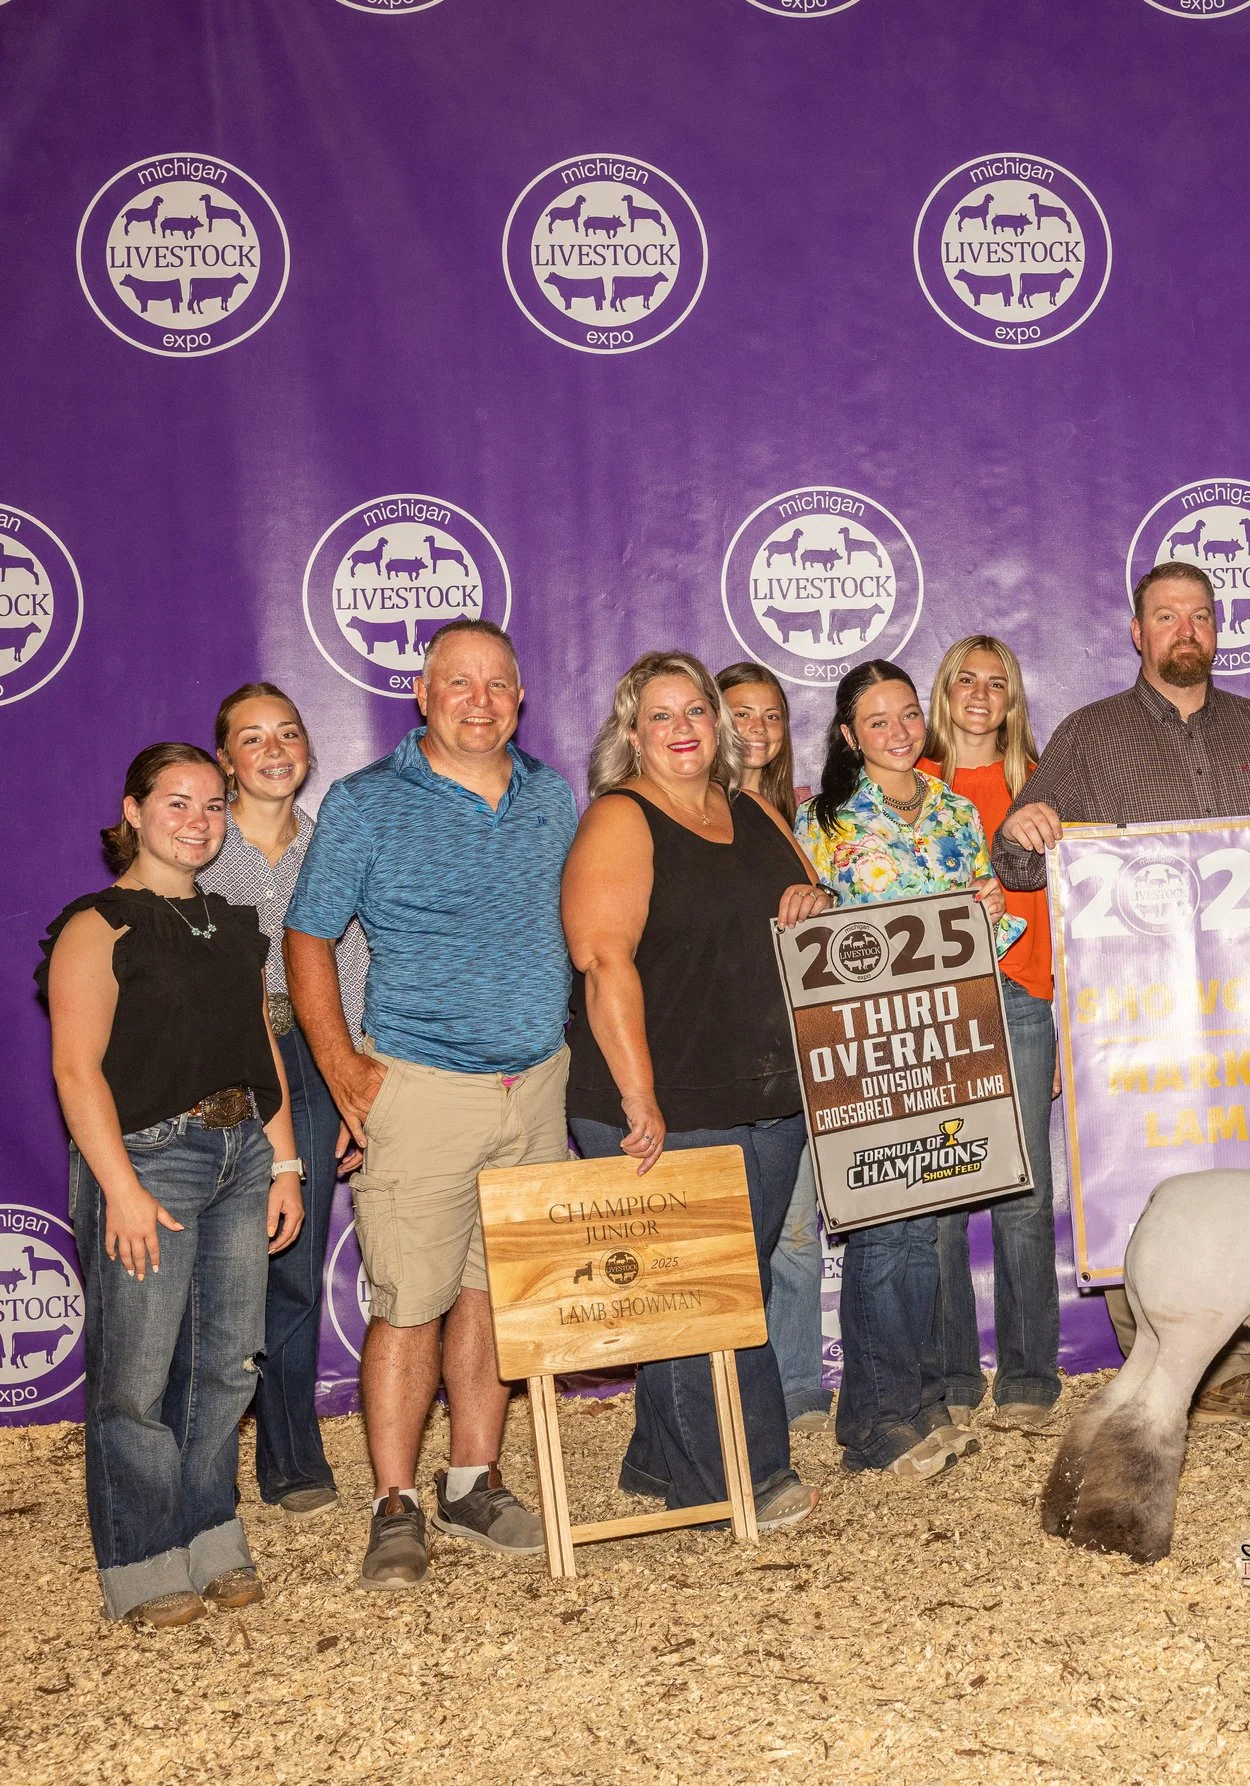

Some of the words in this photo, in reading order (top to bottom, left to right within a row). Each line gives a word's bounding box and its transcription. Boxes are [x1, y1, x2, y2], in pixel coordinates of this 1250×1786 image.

[1181, 0, 1224, 13] expo
[138, 159, 227, 184] michigan
[561, 159, 648, 184] michigan
[970, 159, 1054, 182] michigan
[109, 245, 257, 268] LIVESTOCK
[534, 244, 677, 266] LIVESTOCK
[944, 241, 1081, 263] LIVESTOCK
[163, 333, 211, 351] expo
[587, 331, 633, 348] expo
[995, 326, 1040, 343] expo
[363, 500, 450, 526] michigan
[779, 492, 864, 517] michigan
[336, 585, 479, 610] LIVESTOCK
[752, 576, 892, 600] LIVESTOCK
[803, 662, 851, 681] expo
[840, 946, 880, 960] LIVESTOCK
[832, 986, 960, 1038] THIRD
[809, 1019, 994, 1083] OVERALL
[862, 1069, 933, 1097] DIVISION
[946, 1062, 952, 1082] I
[815, 1097, 893, 1131] CROSSBRED
[904, 1084, 957, 1113] MARKET
[968, 1074, 1005, 1099] LAMB
[854, 1141, 922, 1166] FORMULA
[927, 1135, 944, 1149] OF
[848, 1139, 987, 1188] CHAMPIONS
[923, 1169, 953, 1182] SHOW
[955, 1162, 981, 1176] FEED
[549, 1191, 688, 1225] CHAMPION
[586, 1220, 659, 1245] JUNIOR
[651, 1256, 679, 1270] 2025
[559, 1302, 607, 1325] LAMB
[611, 1290, 702, 1319] SHOWMAN
